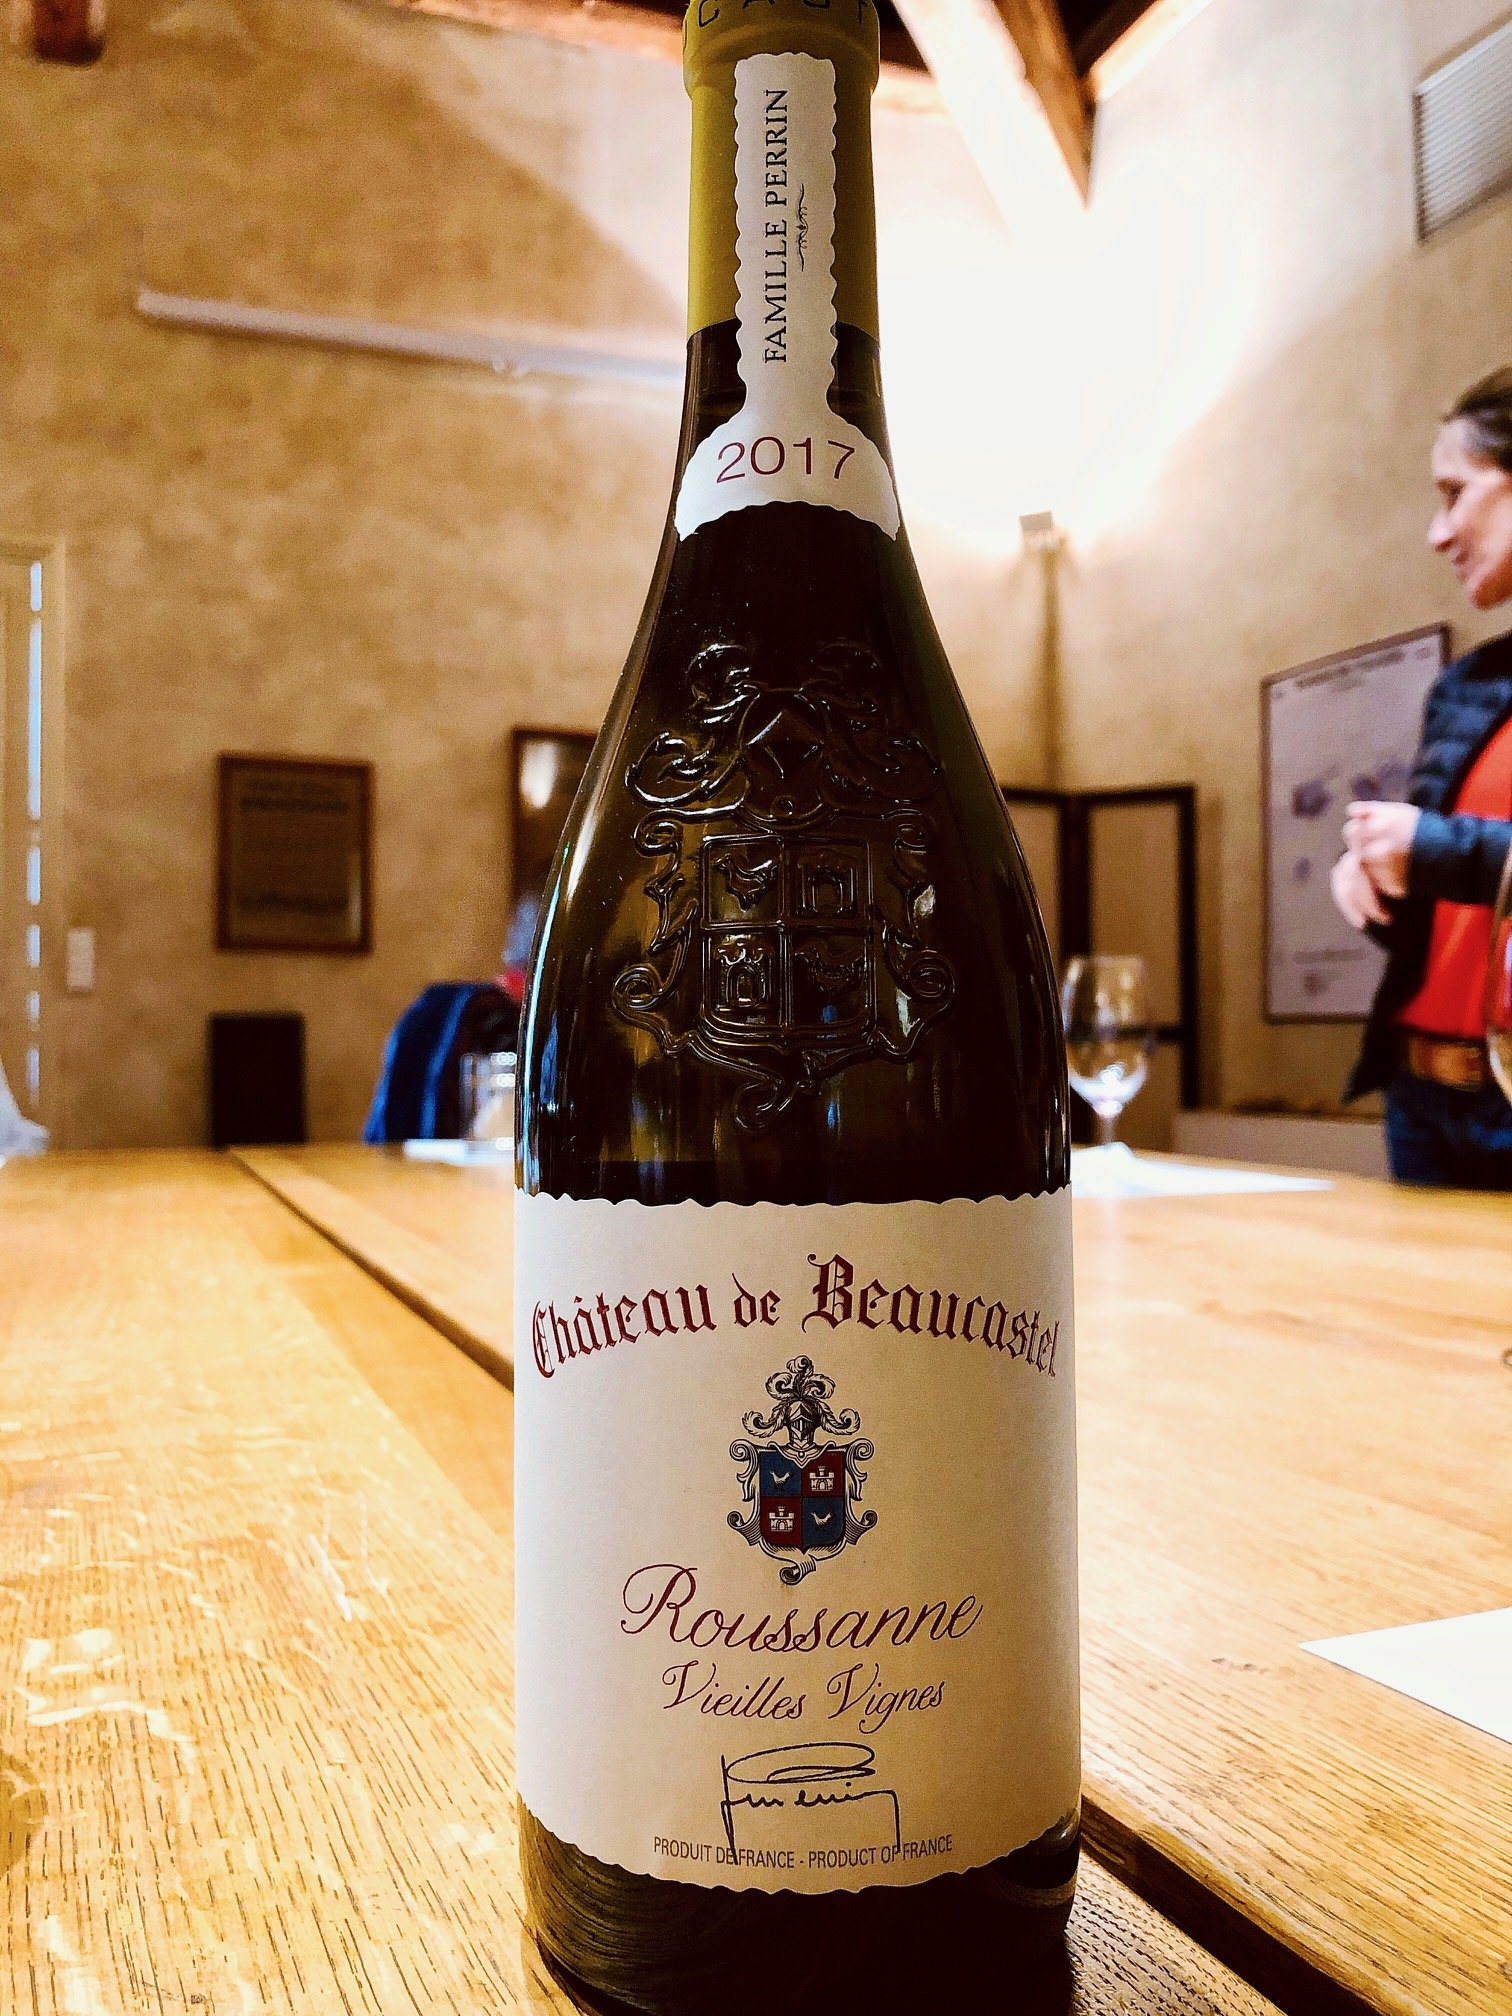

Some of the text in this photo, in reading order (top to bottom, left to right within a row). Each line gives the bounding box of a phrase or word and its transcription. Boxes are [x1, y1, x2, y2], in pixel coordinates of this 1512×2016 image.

[764, 88, 788, 364] FAMILLE PERRIN
[716, 435, 856, 484] 2017
[532, 1253, 1060, 1379] Château de Beaucastel
[620, 1563, 984, 1652] Roussanne
[662, 1659, 945, 1735] Vieilles Vignes
[653, 1836, 712, 1863] PRODUIT
[716, 1846, 735, 1865] DE
[738, 1848, 795, 1869] FRANCE
[808, 1847, 877, 1869] PRODUCT
[902, 1834, 953, 1861] FRANCE
